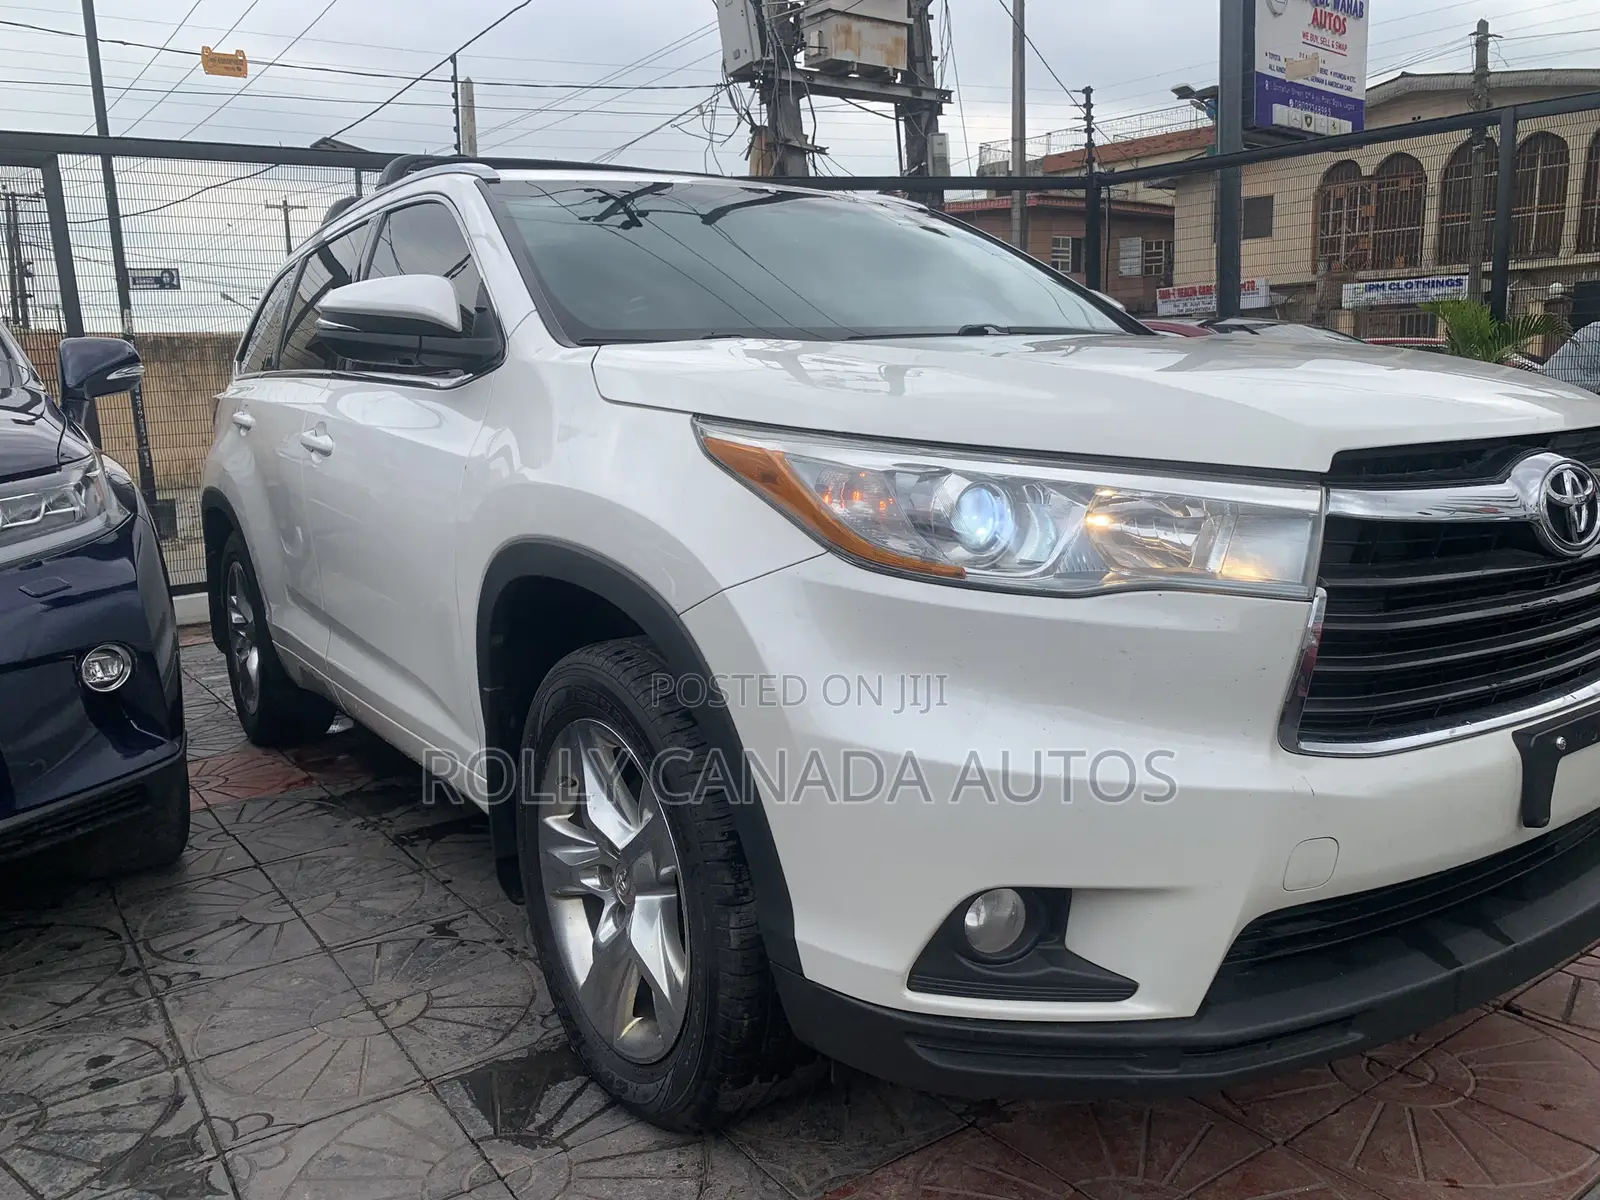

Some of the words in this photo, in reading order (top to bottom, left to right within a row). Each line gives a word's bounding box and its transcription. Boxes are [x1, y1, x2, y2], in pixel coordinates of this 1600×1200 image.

[1333, 0, 1364, 18] WAHAB
[1311, 8, 1347, 35] AUTOS
[1302, 31, 1310, 40] WE
[1320, 36, 1331, 48] SELL
[1336, 42, 1348, 52] SWAP
[1268, 52, 1281, 62] TOYOTA
[1388, 278, 1464, 291] CLOTHINGS
